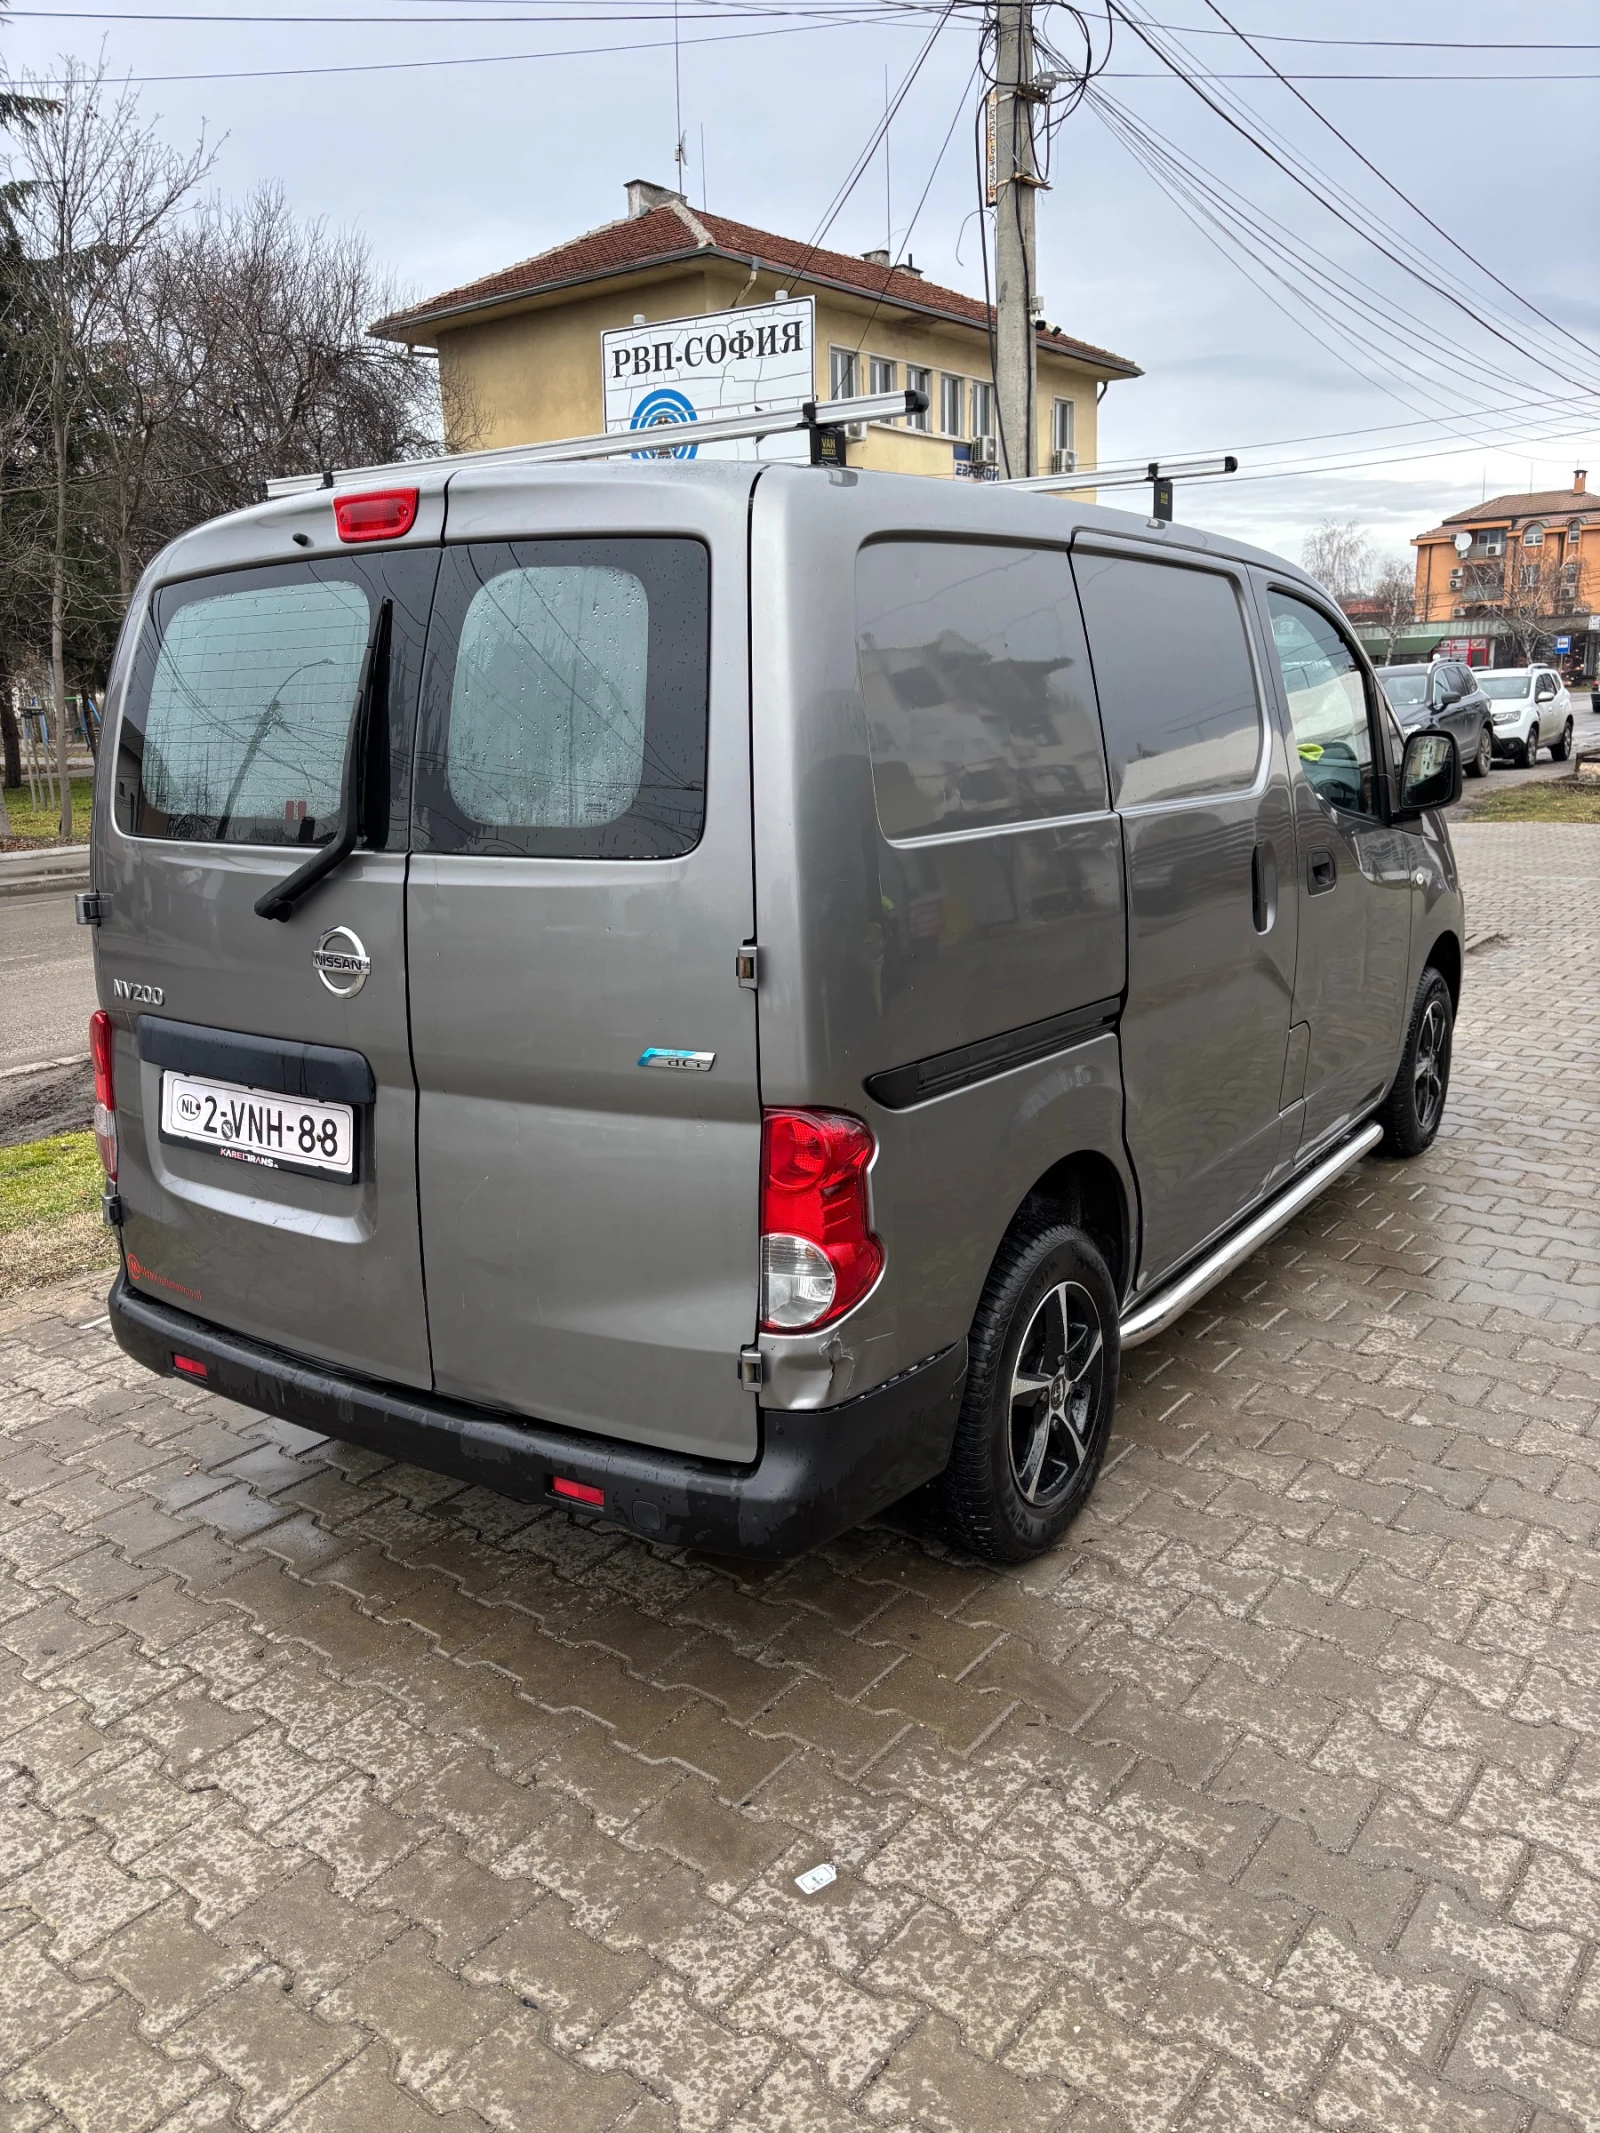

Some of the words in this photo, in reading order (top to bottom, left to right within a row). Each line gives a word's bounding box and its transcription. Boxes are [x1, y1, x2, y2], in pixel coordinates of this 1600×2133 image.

[612, 320, 804, 379] РВП-СОФИЯ
[821, 437, 836, 449] VAN
[315, 953, 362, 971] NISSAN
[113, 978, 165, 1006] NV200
[180, 1098, 197, 1116] NL
[203, 1095, 338, 1157] 2-VNH-88
